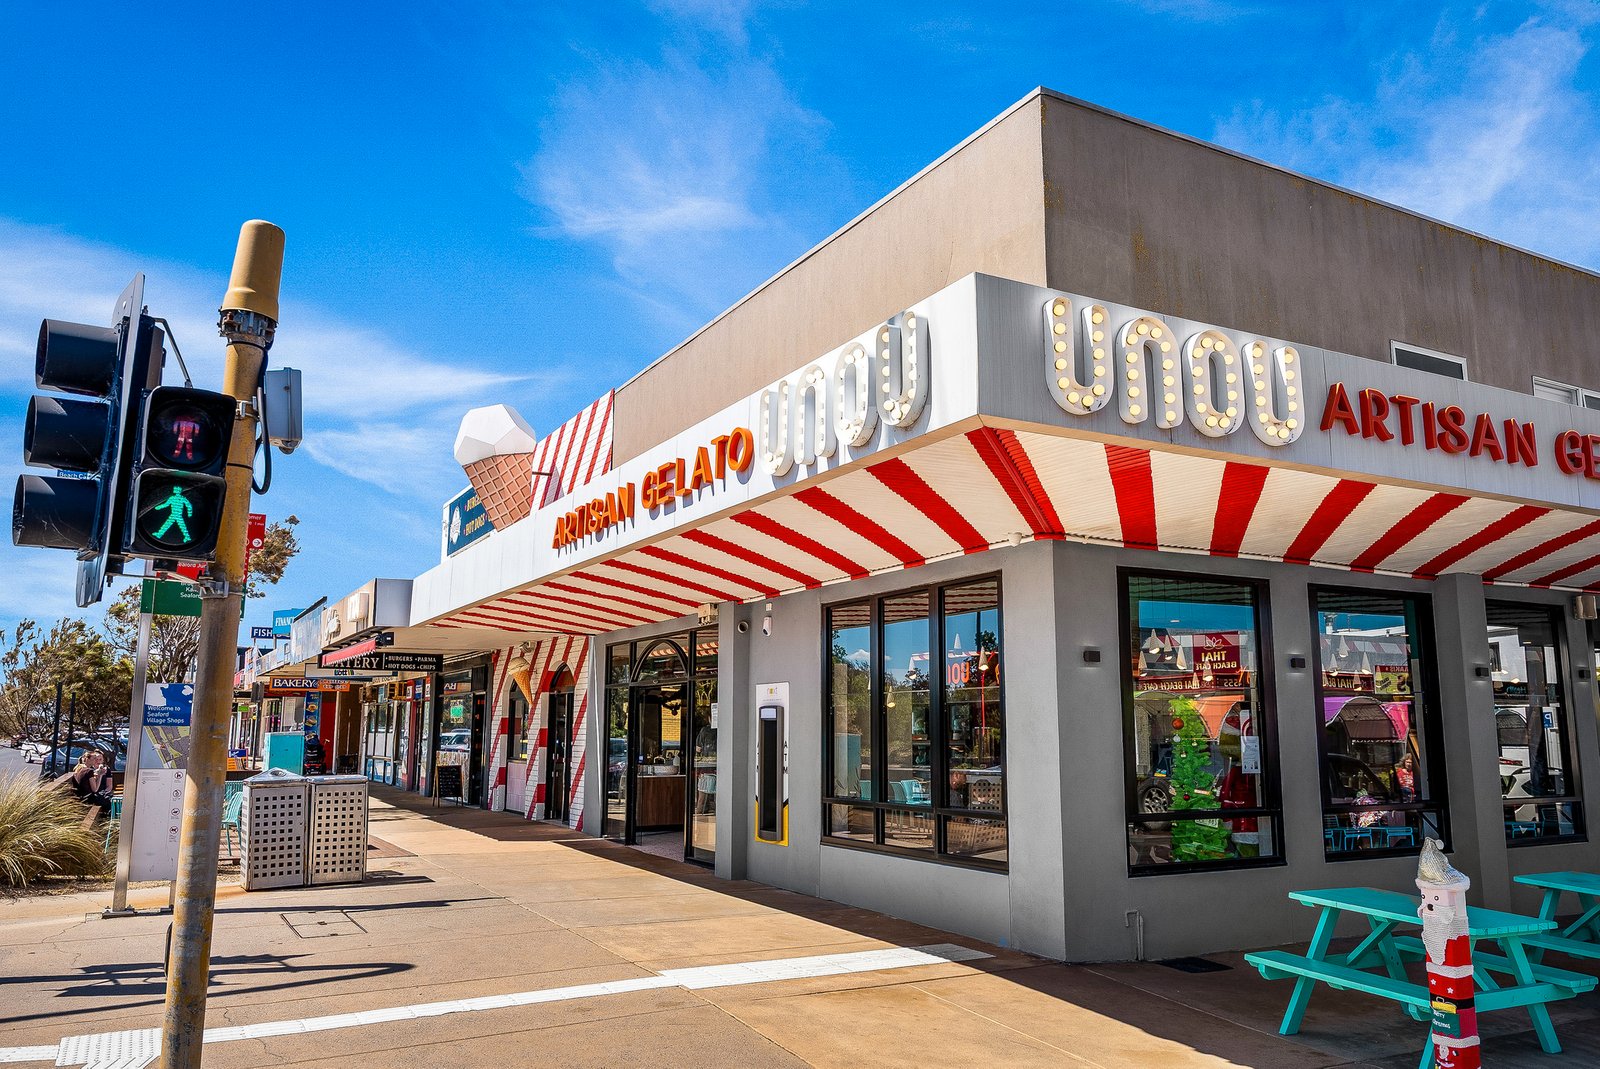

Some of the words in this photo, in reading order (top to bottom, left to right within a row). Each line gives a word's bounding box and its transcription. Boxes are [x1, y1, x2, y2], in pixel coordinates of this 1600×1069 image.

[1319, 381, 1539, 468] ARTISAN
[552, 482, 635, 549] ARTISAN
[641, 427, 754, 510] GELATO
[254, 628, 273, 636] FISH
[329, 656, 380, 669] ATERY
[273, 678, 314, 688] BAKERY
